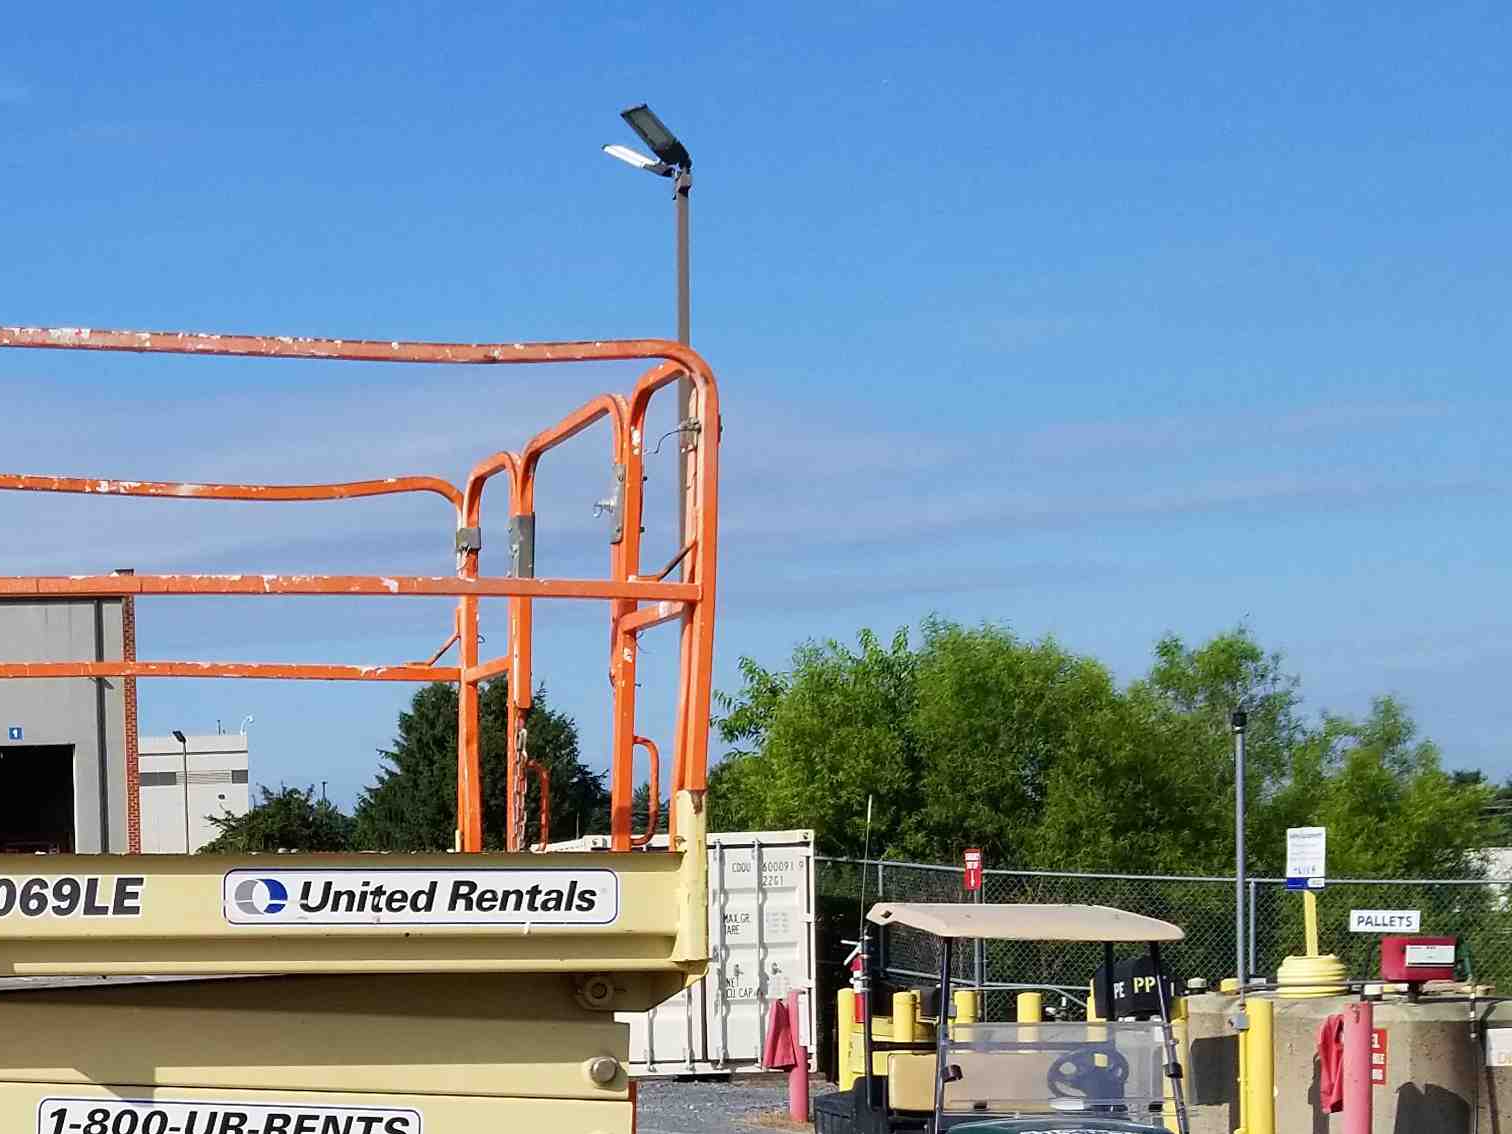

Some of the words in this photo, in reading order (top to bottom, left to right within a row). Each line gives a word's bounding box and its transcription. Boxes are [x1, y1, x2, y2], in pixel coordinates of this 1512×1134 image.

[299, 880, 438, 913] United
[447, 880, 597, 913] Rentals
[1357, 915, 1413, 927] PALLETS
